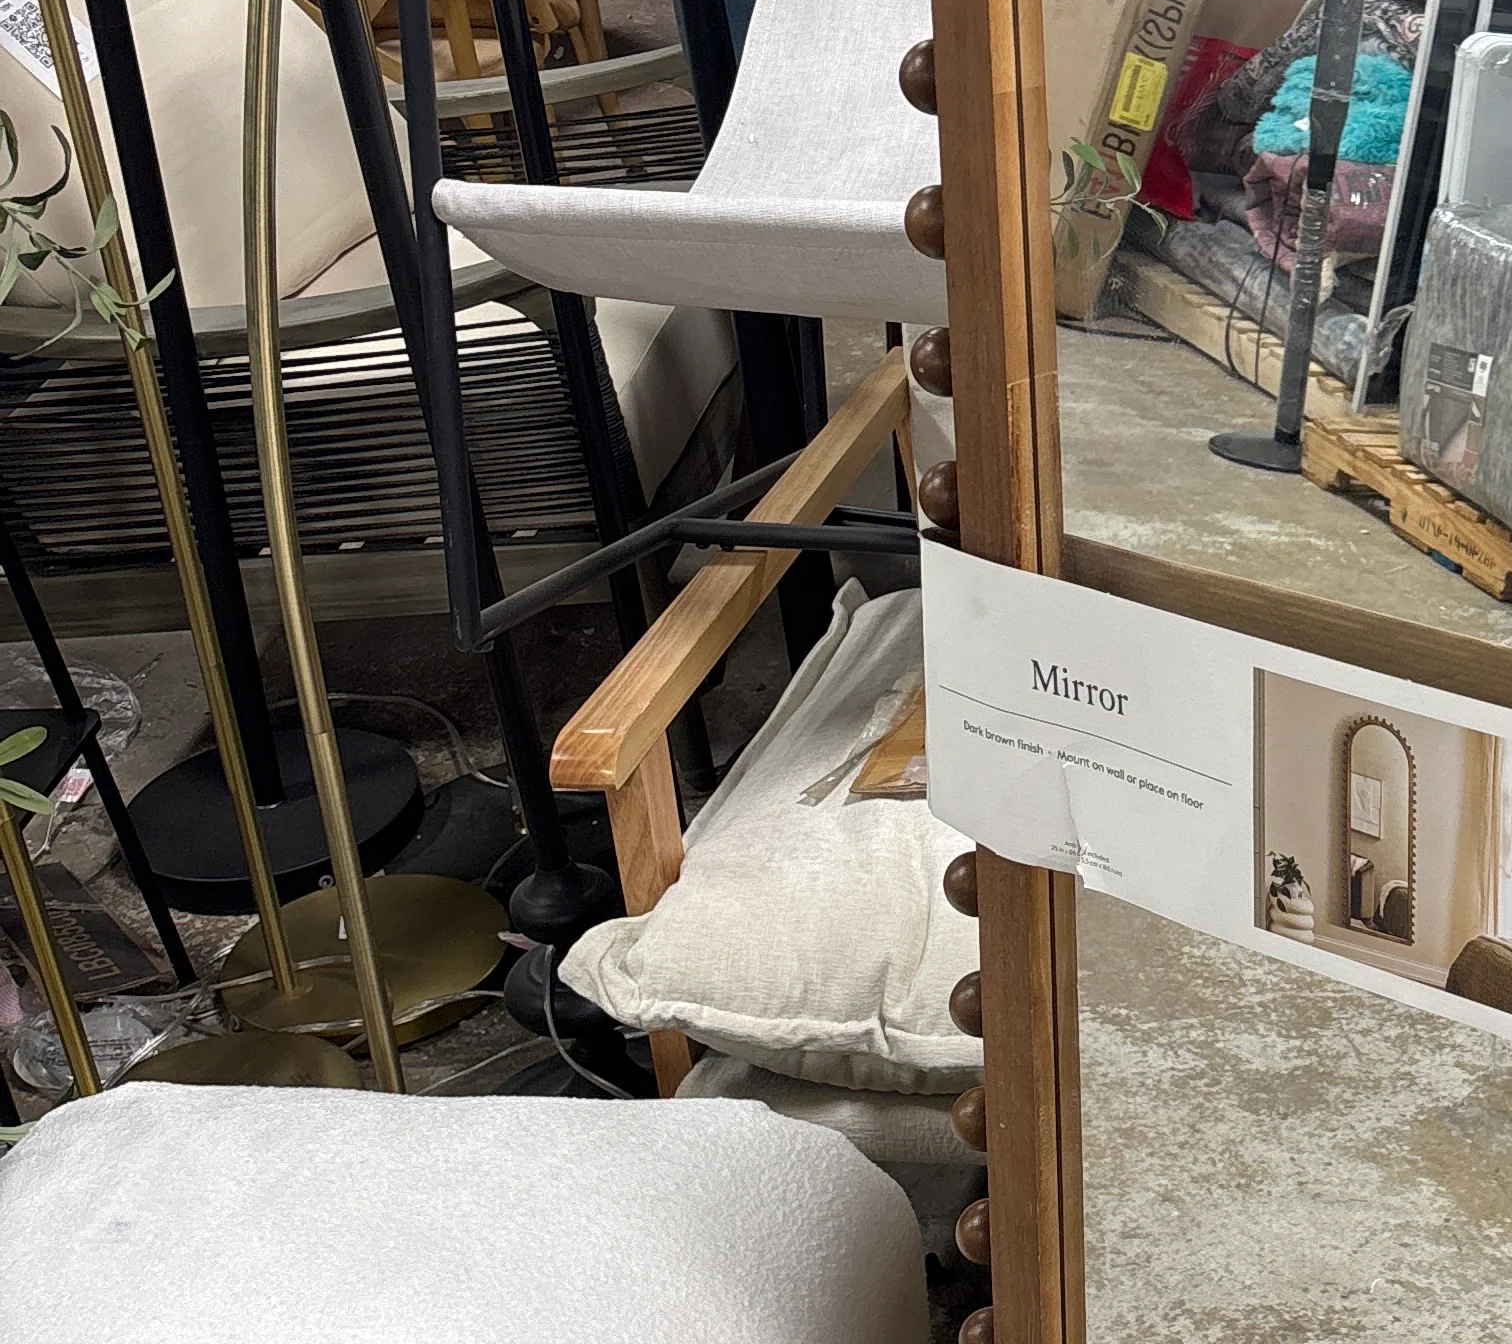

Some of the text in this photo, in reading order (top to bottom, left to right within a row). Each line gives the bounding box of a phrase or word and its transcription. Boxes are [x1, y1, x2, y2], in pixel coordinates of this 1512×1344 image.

[1031, 659, 1128, 715] Mirror
[963, 720, 1205, 811] Dark brown finish Mount on wall or place on floor
